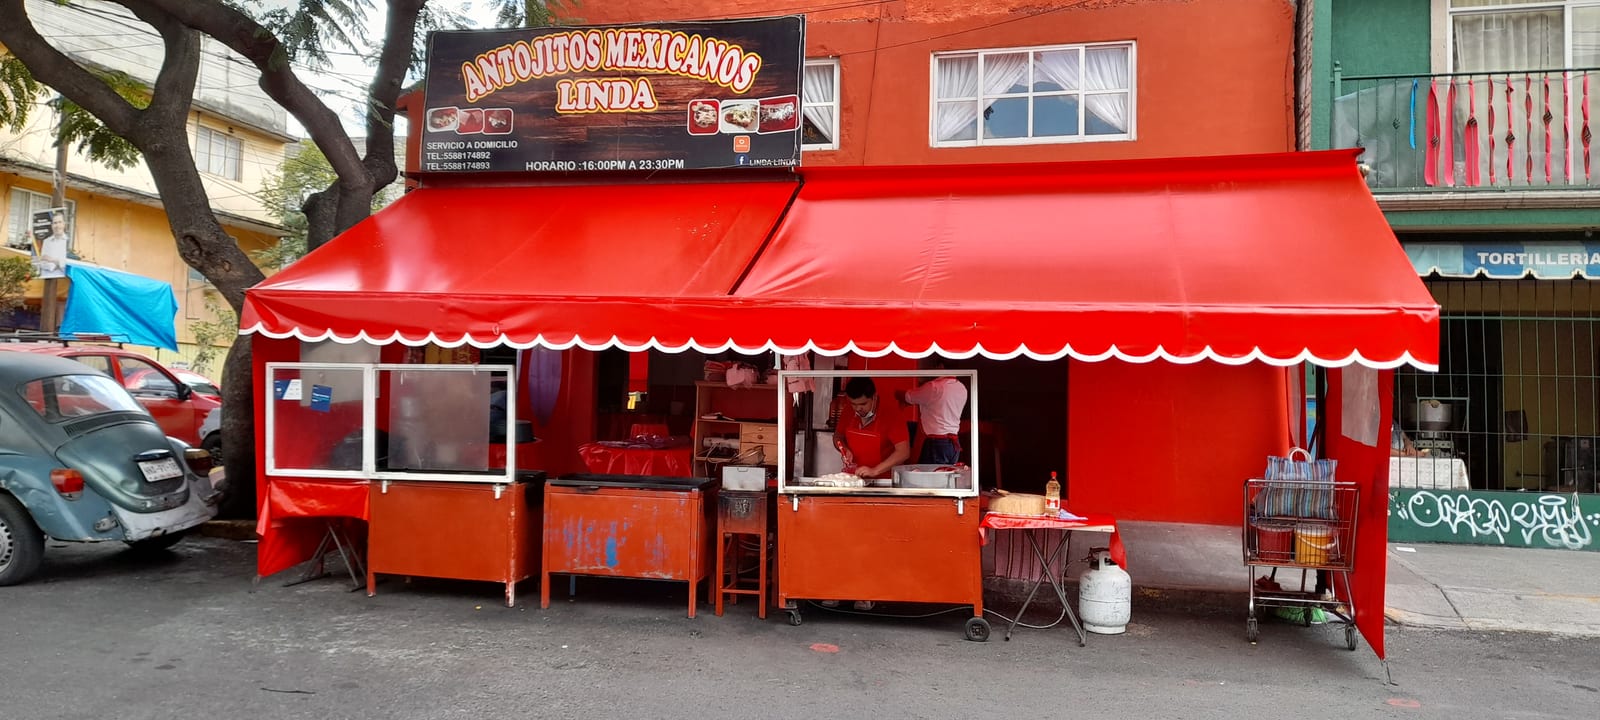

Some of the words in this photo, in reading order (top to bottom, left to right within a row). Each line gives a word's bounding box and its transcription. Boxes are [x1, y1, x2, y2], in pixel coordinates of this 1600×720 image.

[463, 30, 602, 101] ANTOJITOS
[605, 29, 761, 92] MEXICANOS
[556, 77, 658, 113] LINDA
[426, 141, 465, 150] SERVICIO
[466, 141, 473, 149] A
[474, 140, 518, 149] DOMICILIO
[525, 161, 576, 171] HORARIO
[628, 160, 637, 170] A
[639, 159, 684, 170] 23:30PM
